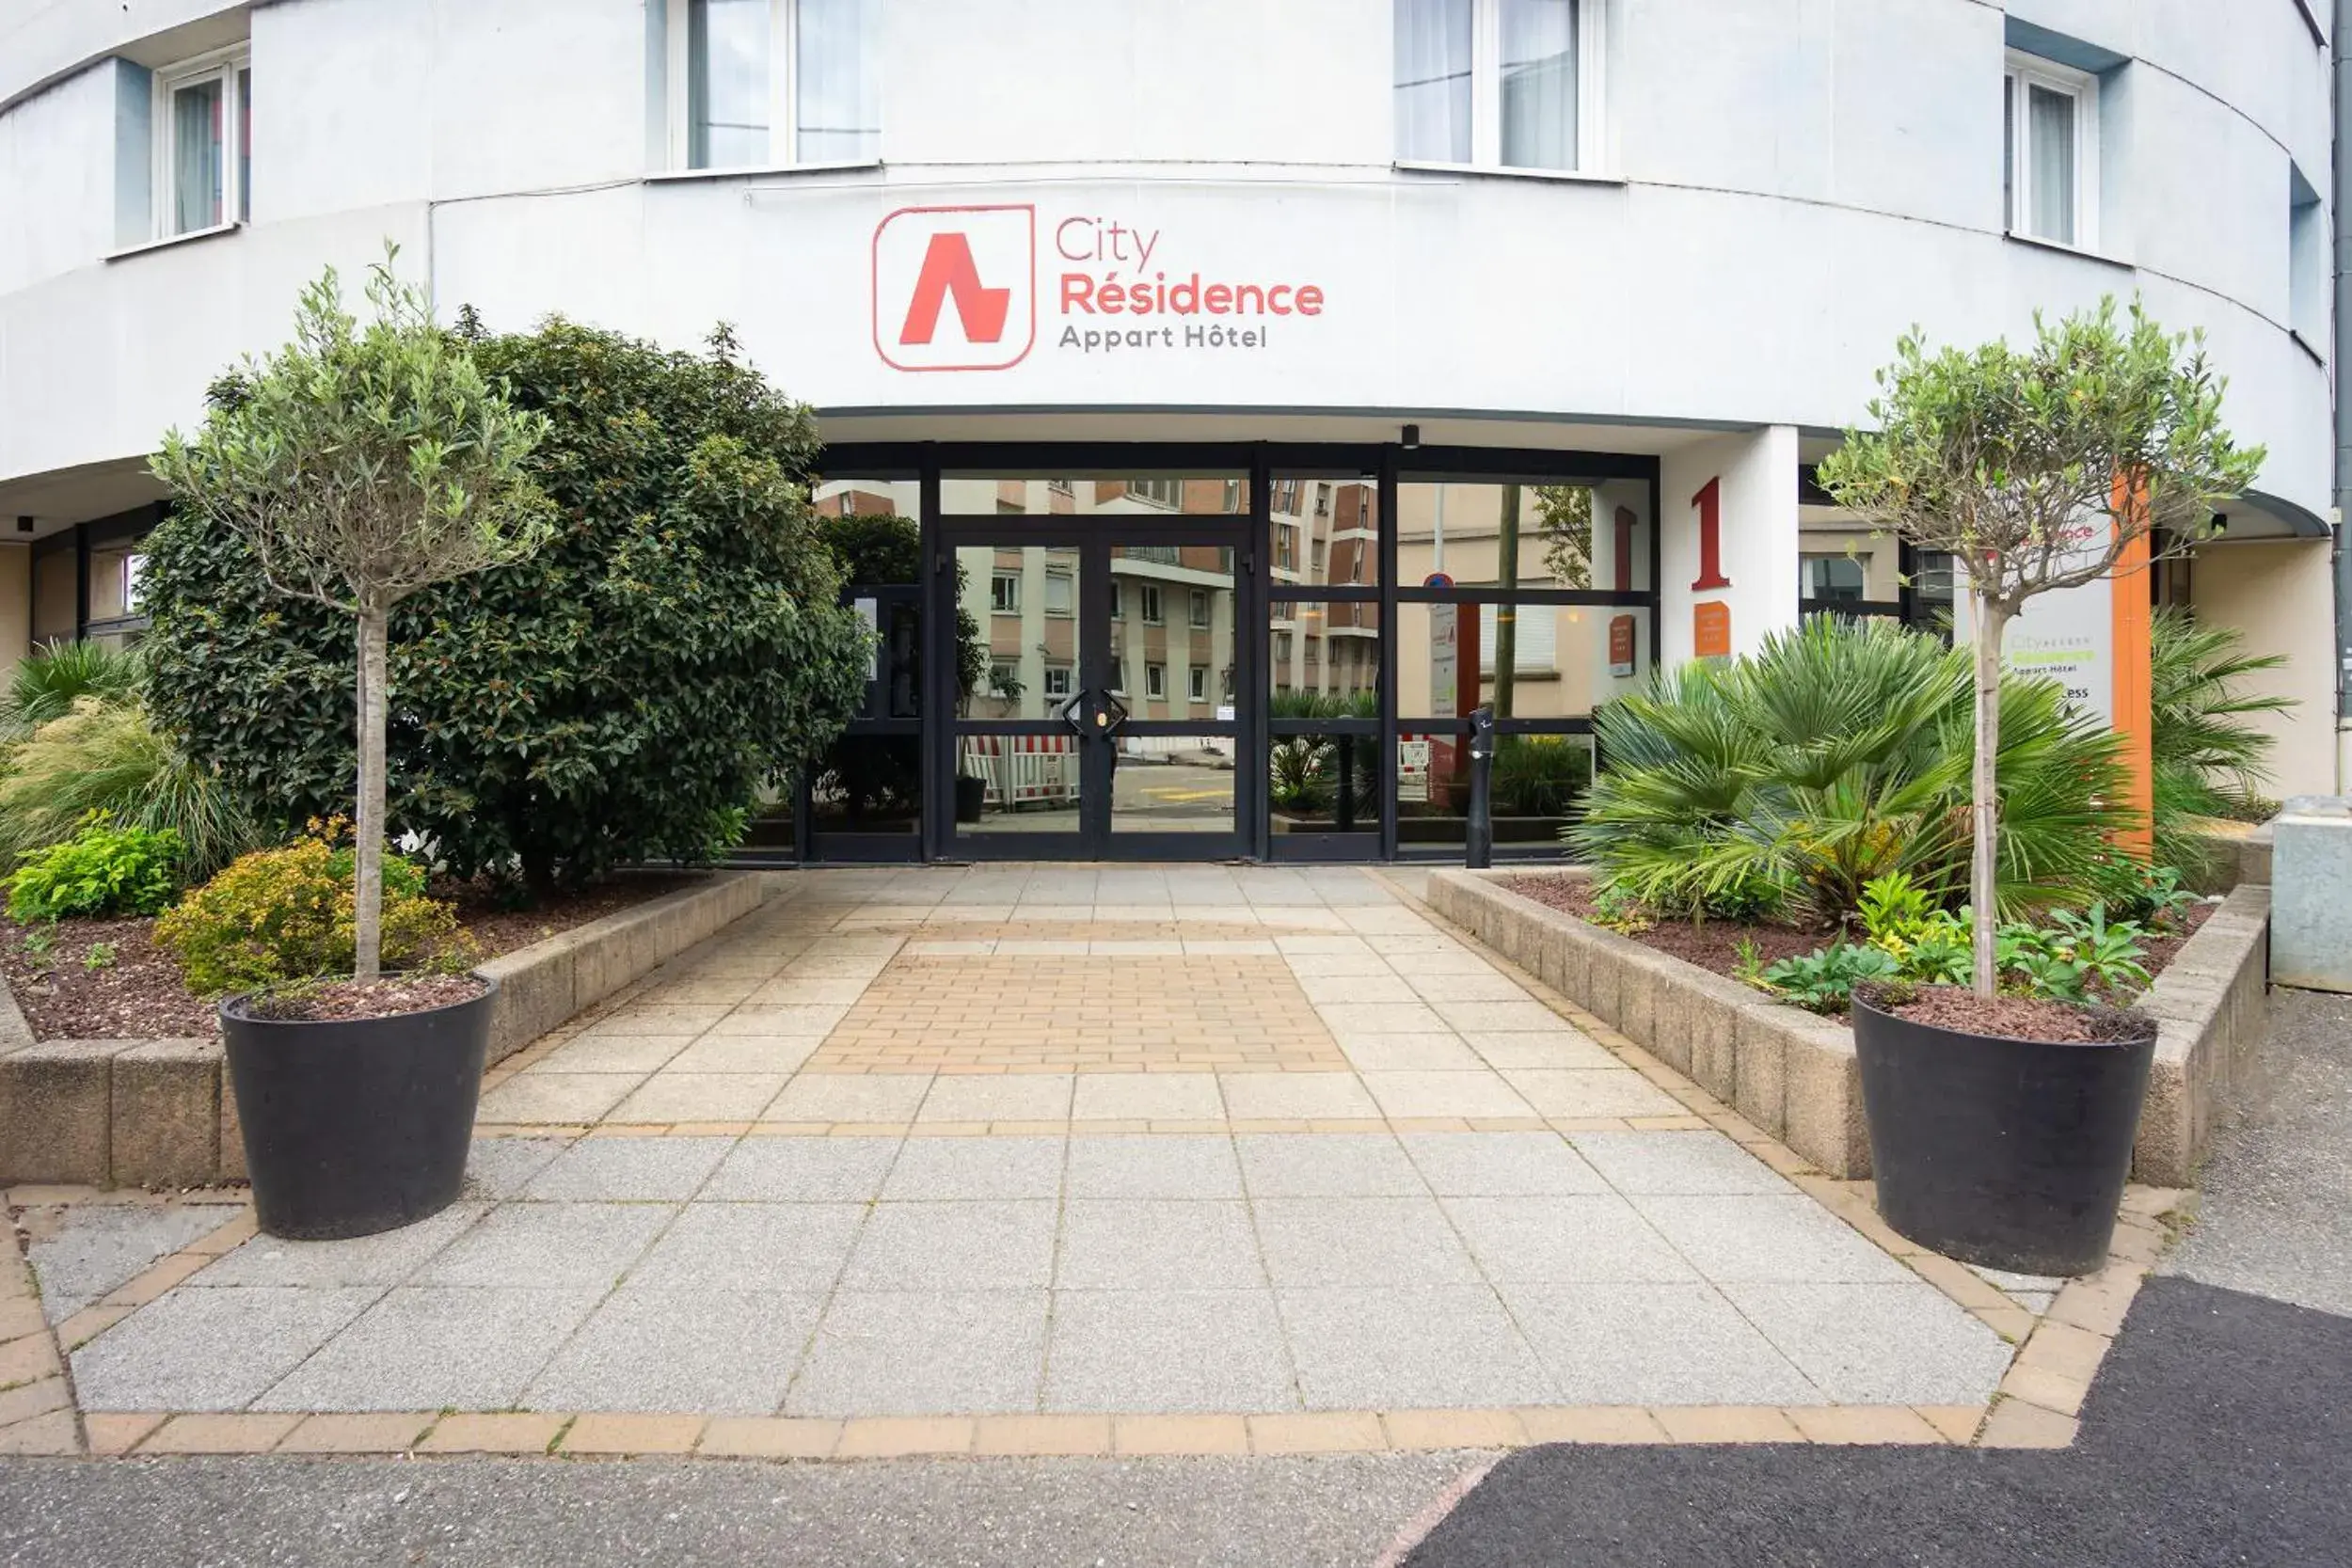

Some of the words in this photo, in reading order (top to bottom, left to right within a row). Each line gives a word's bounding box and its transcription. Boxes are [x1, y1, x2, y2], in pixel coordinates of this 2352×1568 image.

[1056, 217, 1159, 273] City
[1060, 273, 1325, 316] Résidence
[1058, 325, 1173, 353] Appart
[1184, 325, 1267, 349] Hôtel
[1691, 475, 1732, 592] 1
